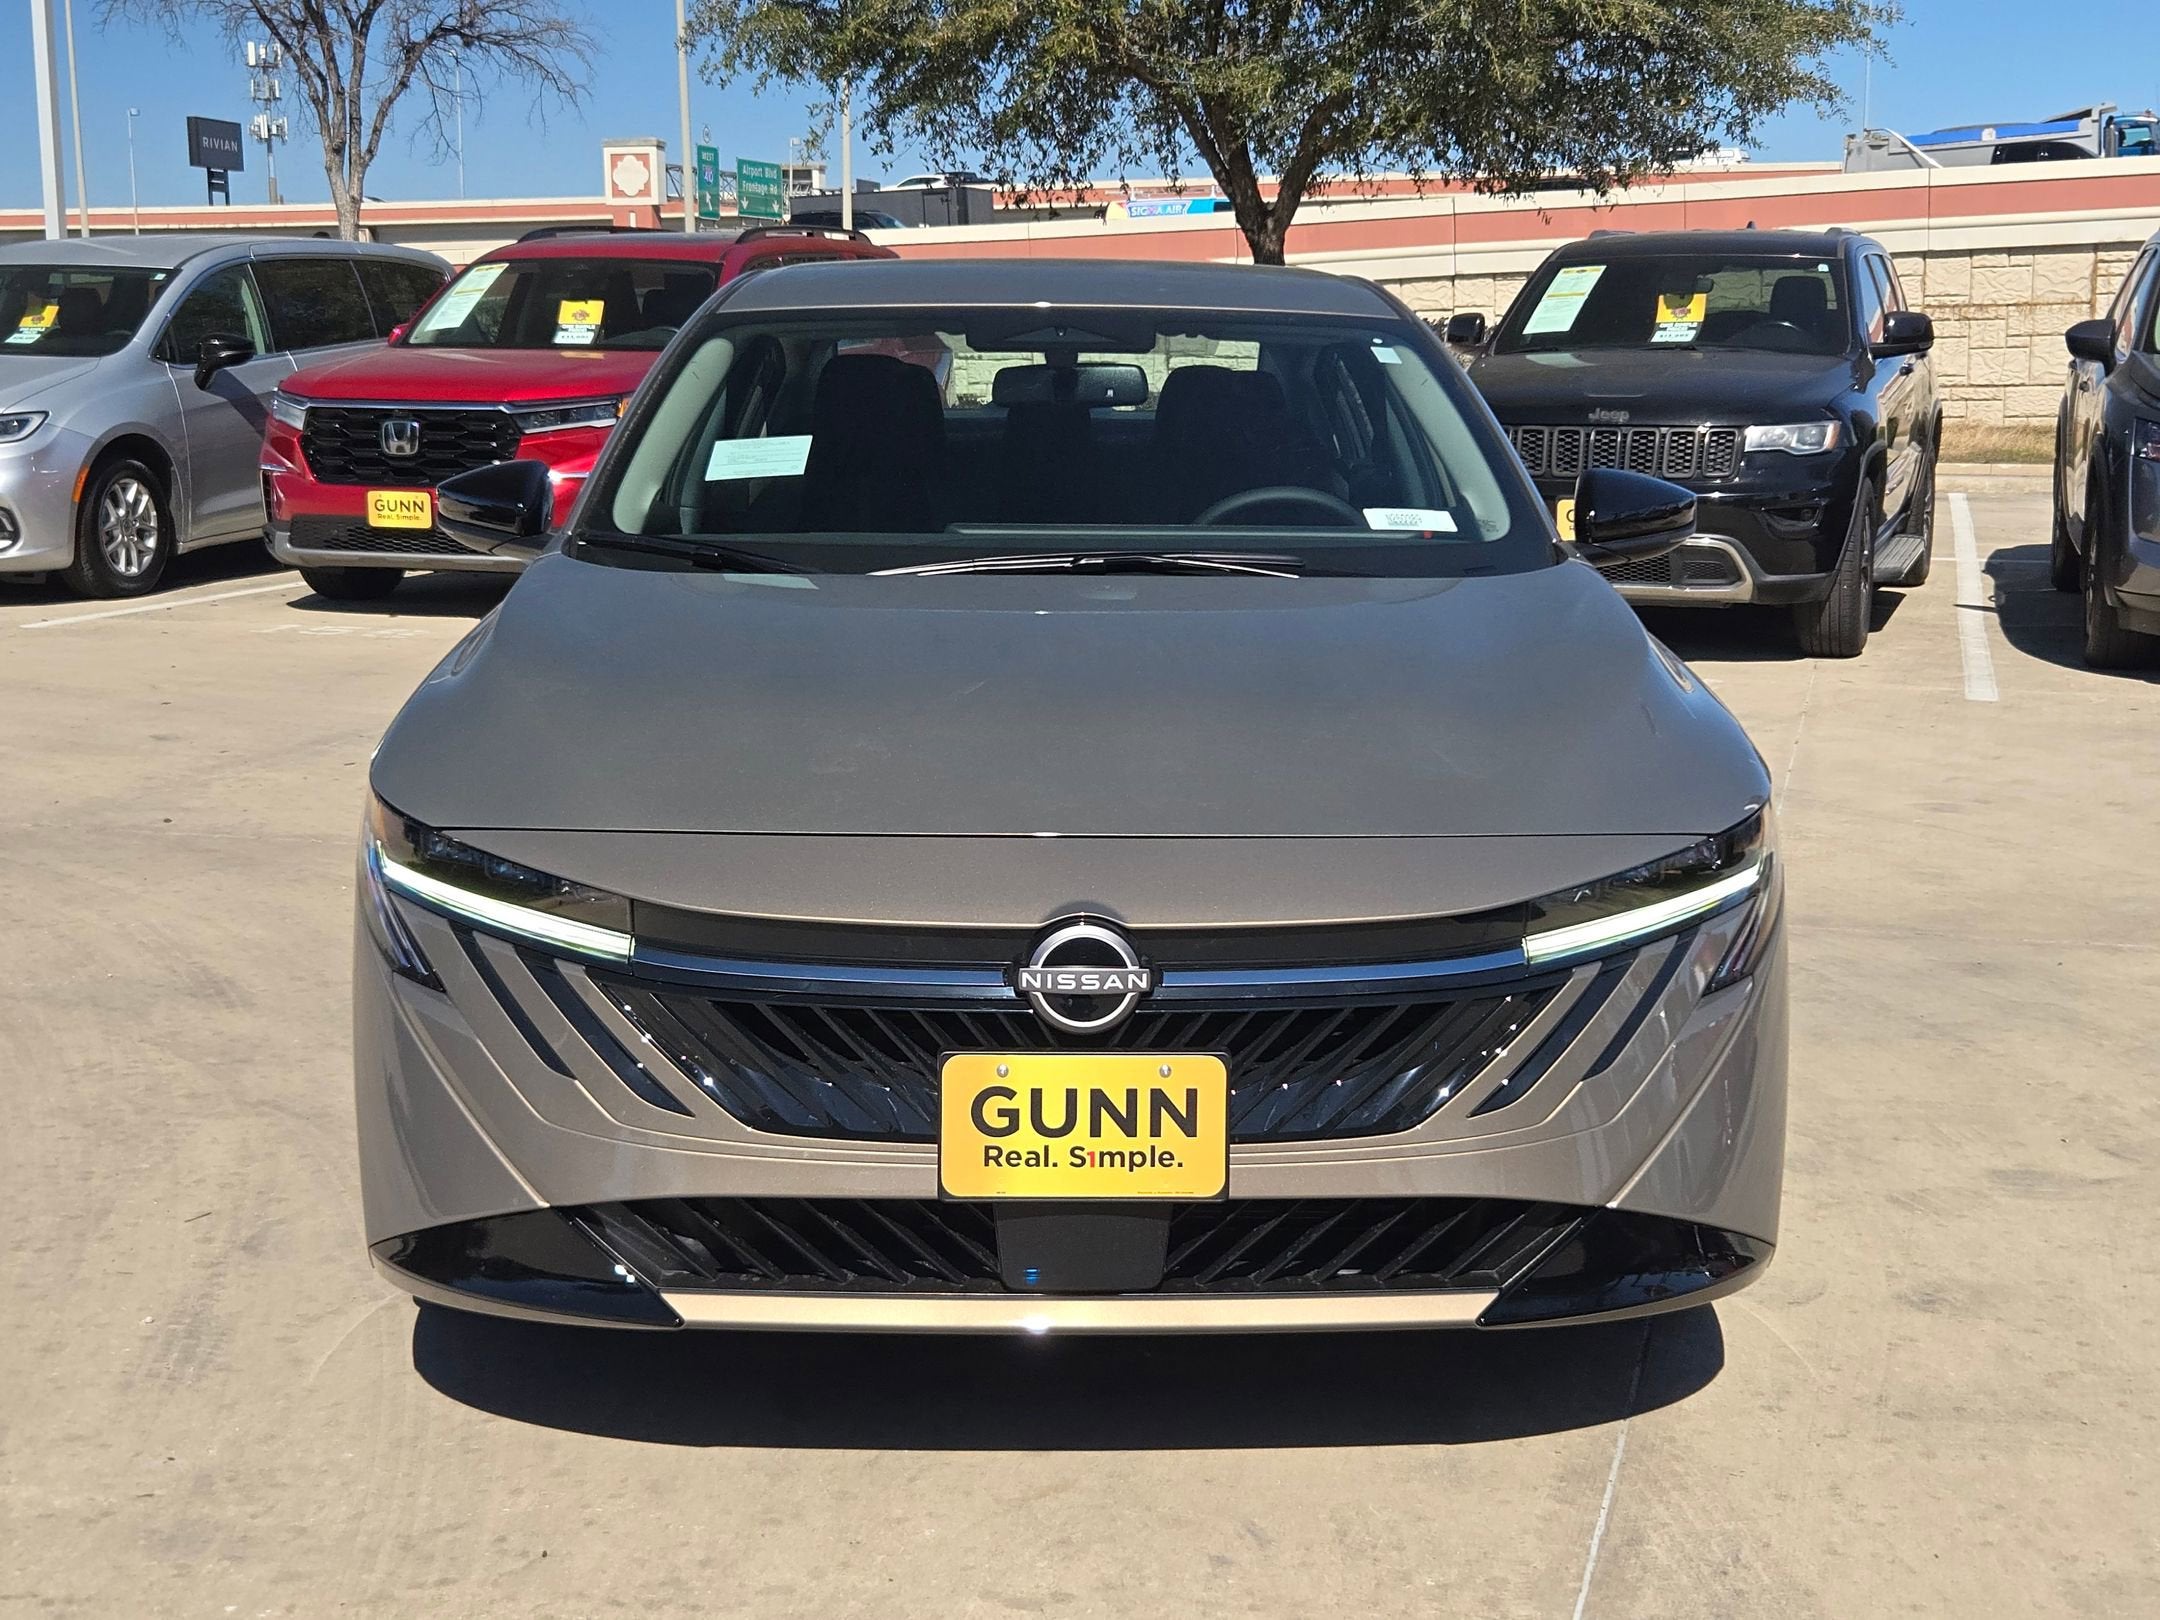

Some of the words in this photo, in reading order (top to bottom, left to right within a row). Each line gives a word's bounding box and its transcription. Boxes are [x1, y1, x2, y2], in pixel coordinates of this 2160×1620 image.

[202, 136, 238, 152] RIVIAN
[742, 164, 763, 178] Airport
[764, 167, 777, 179] Blvd
[742, 180, 768, 196] Frontage
[769, 184, 778, 195] Rd
[1165, 205, 1183, 214] AIR
[1588, 407, 1629, 423] Jeep
[374, 499, 425, 513] GUNN
[1021, 972, 1148, 990] NISSAN
[970, 1085, 1198, 1139] GUNN
[983, 1144, 1058, 1168] Real.
